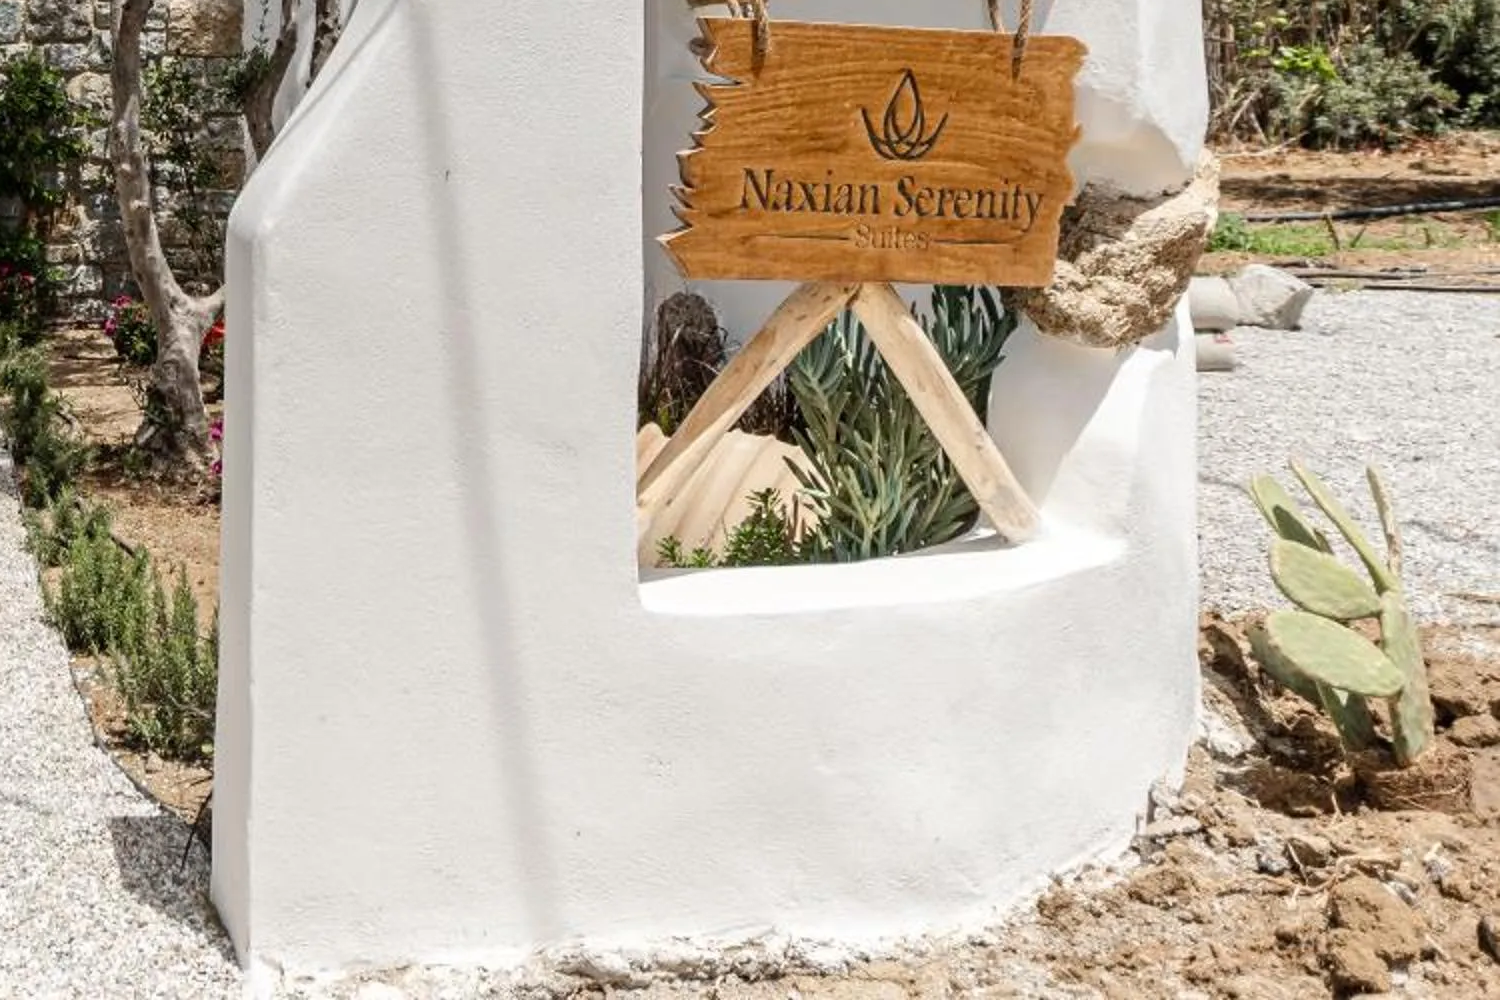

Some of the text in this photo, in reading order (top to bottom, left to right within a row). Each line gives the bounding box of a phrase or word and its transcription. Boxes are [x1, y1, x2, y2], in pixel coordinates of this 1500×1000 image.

[741, 167, 1045, 230] Naxian Serenity
[854, 224, 931, 250] Suites
